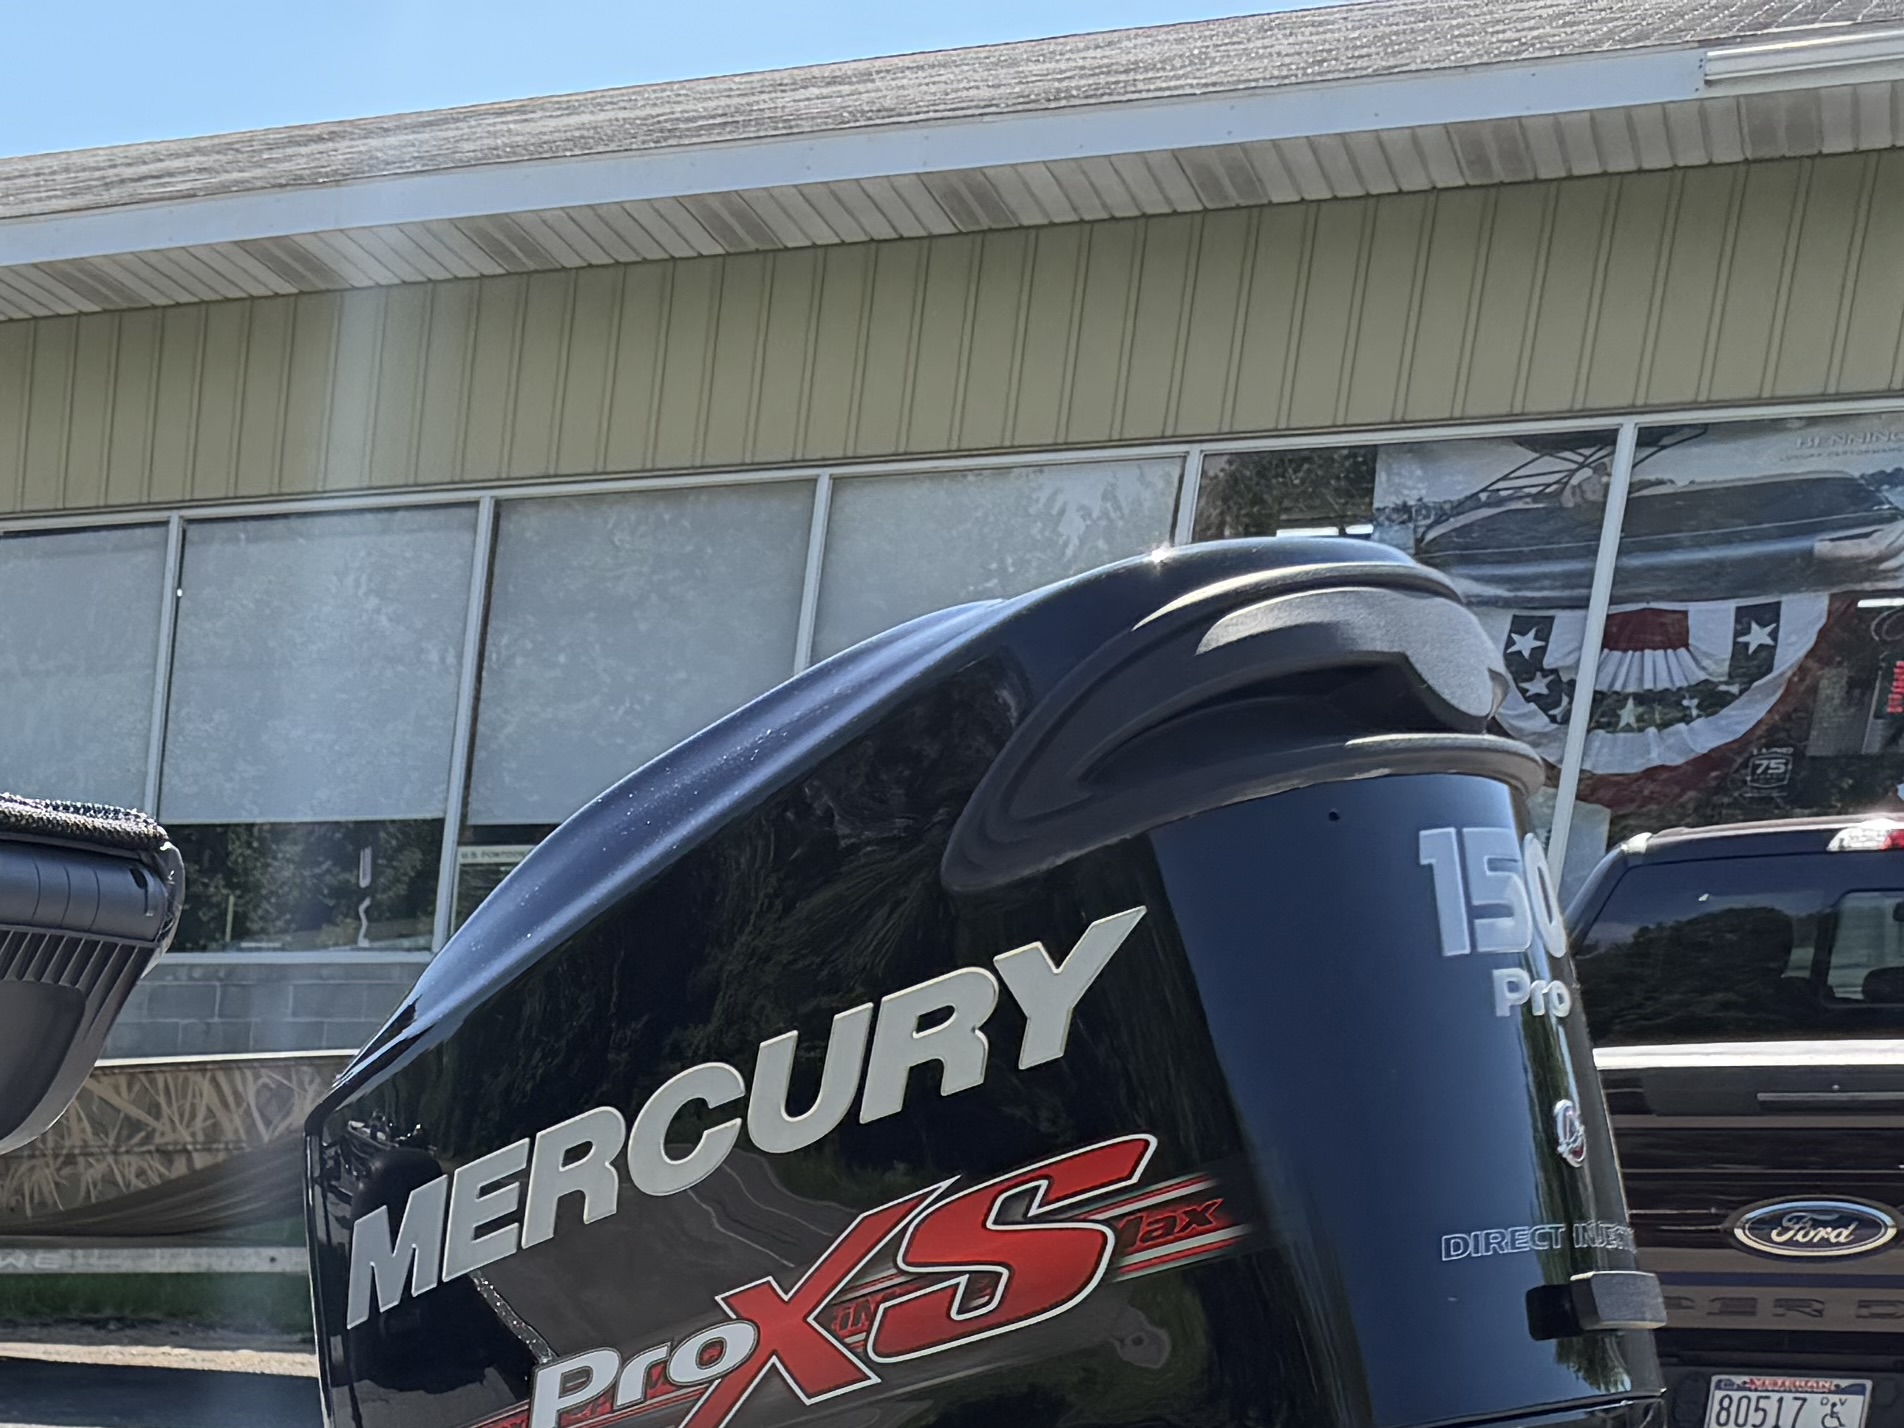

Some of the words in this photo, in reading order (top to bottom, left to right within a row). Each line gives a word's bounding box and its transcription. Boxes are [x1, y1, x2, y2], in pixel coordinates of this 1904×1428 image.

[1418, 827, 1568, 959] 150
[1492, 966, 1573, 1018] Pro
[346, 905, 1147, 1329] MERCURY
[1441, 1223, 1567, 1261] DIRECT
[1770, 1212, 1860, 1244] Ford
